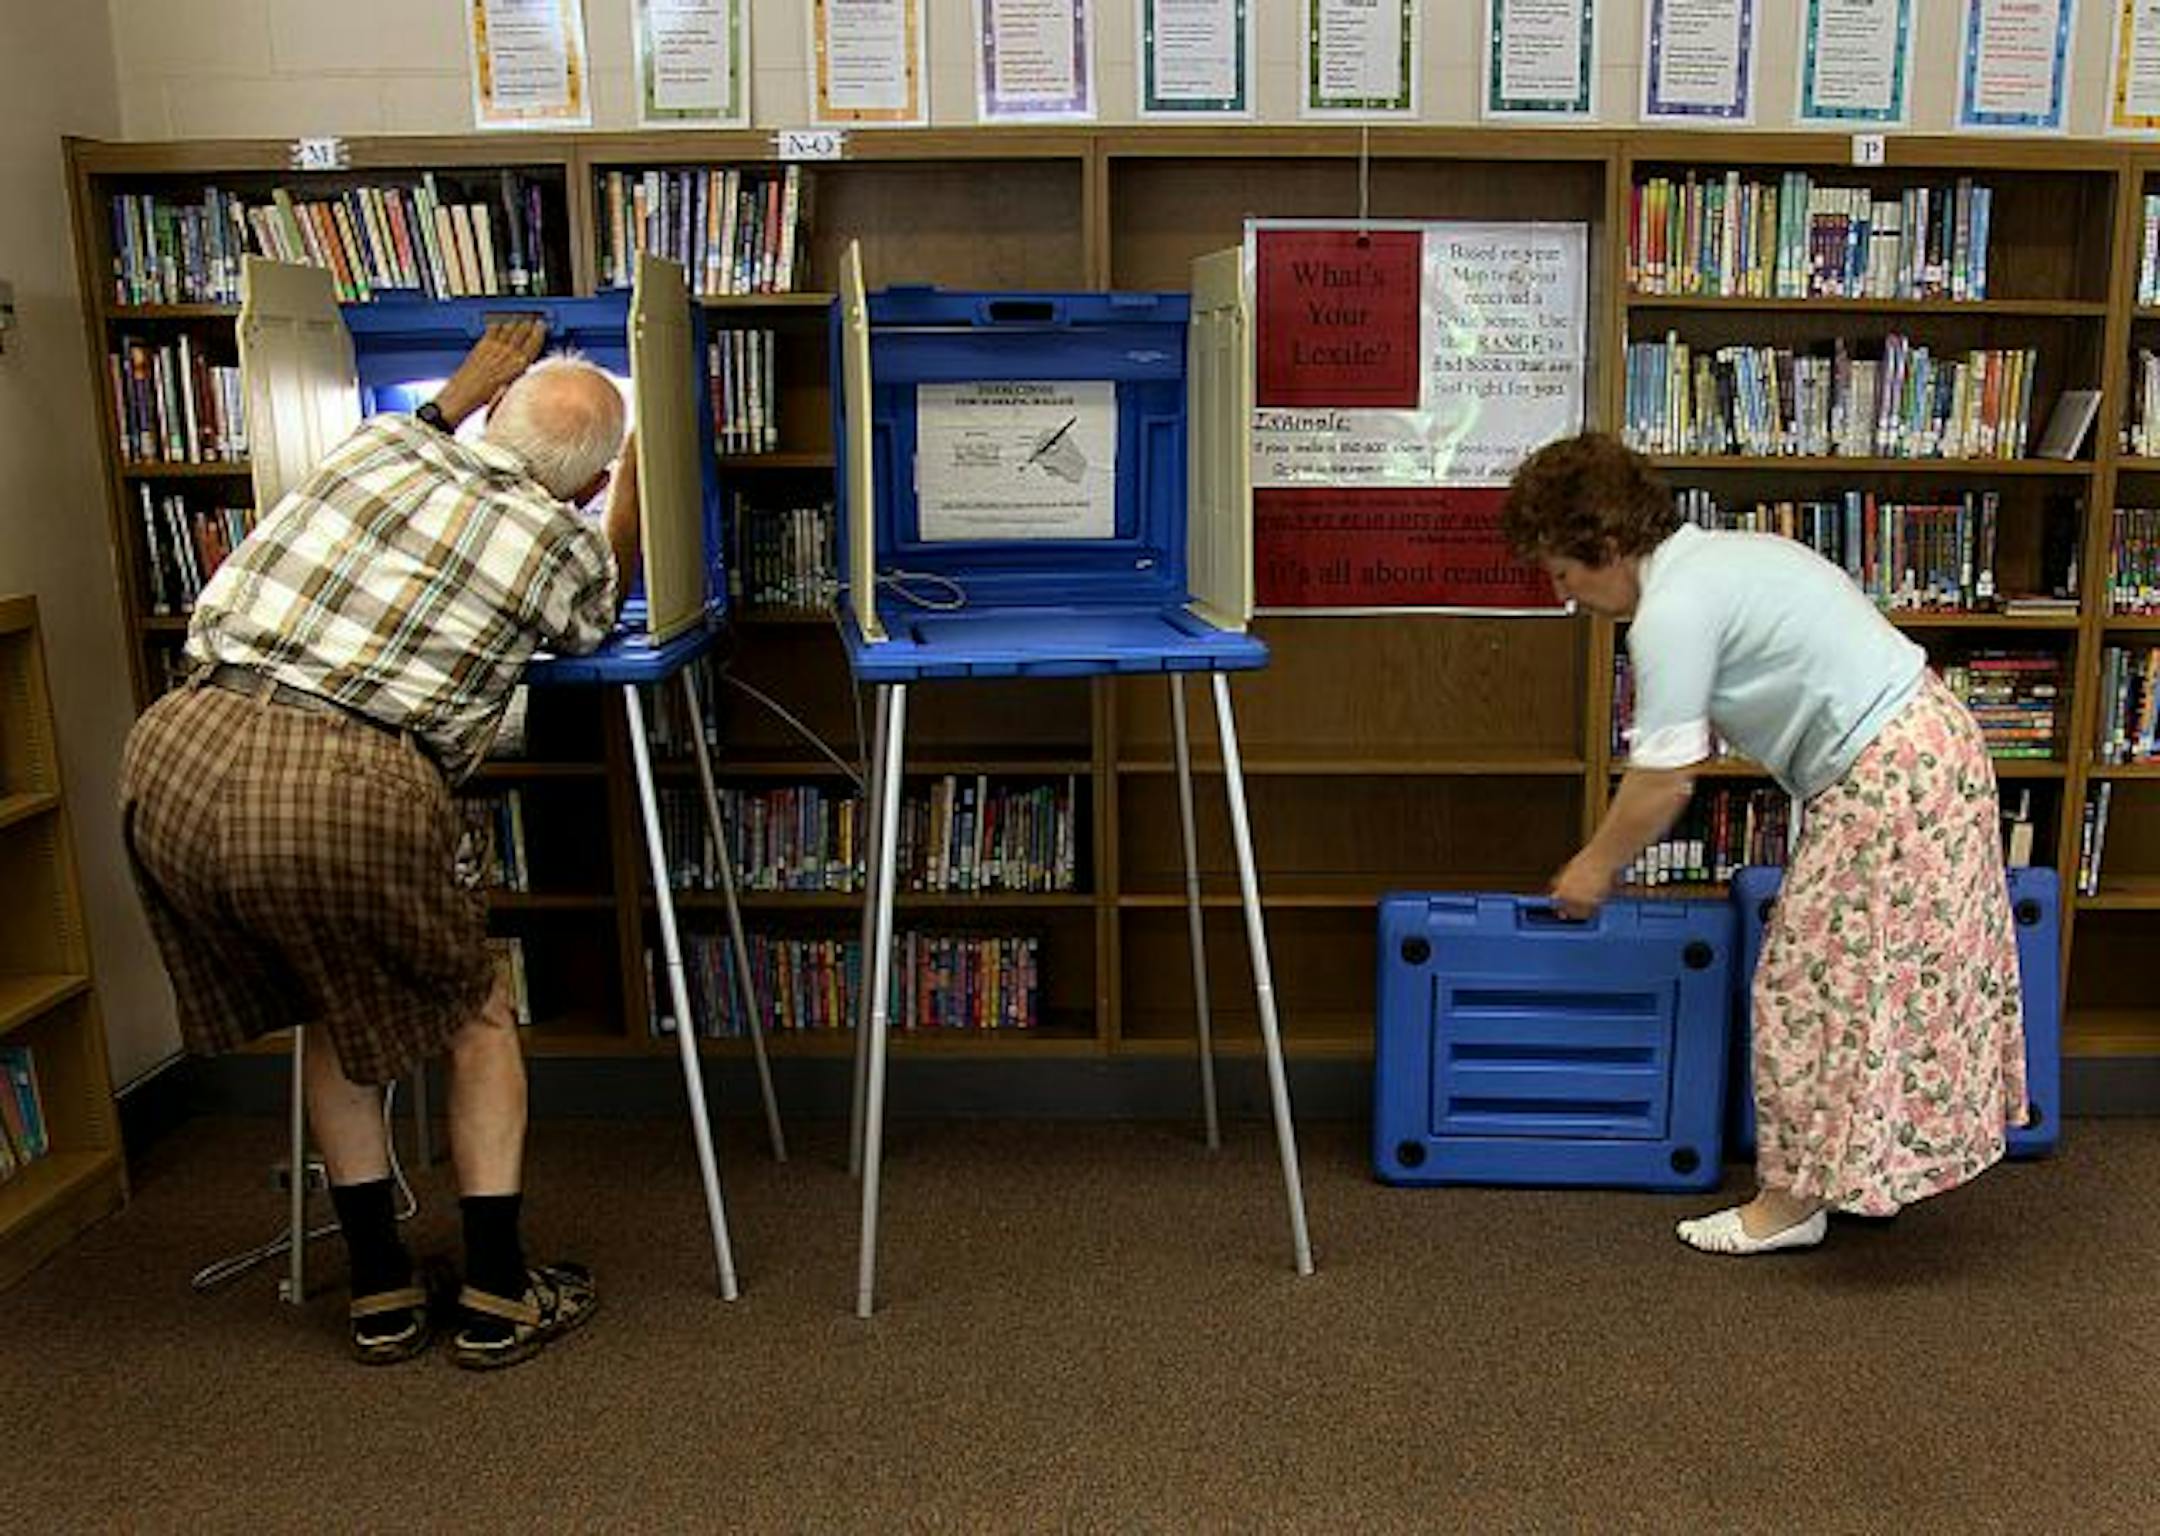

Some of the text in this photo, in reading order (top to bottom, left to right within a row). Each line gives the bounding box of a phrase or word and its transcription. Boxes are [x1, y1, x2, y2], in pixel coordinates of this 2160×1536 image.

[1451, 243, 1497, 261] Based
[1292, 259, 1386, 288] What's
[1307, 299, 1369, 326] Your
[1477, 333, 1543, 351] RANGE
[1465, 356, 1513, 372] books
[1318, 557, 1352, 585] all
[1361, 557, 1433, 585] about
